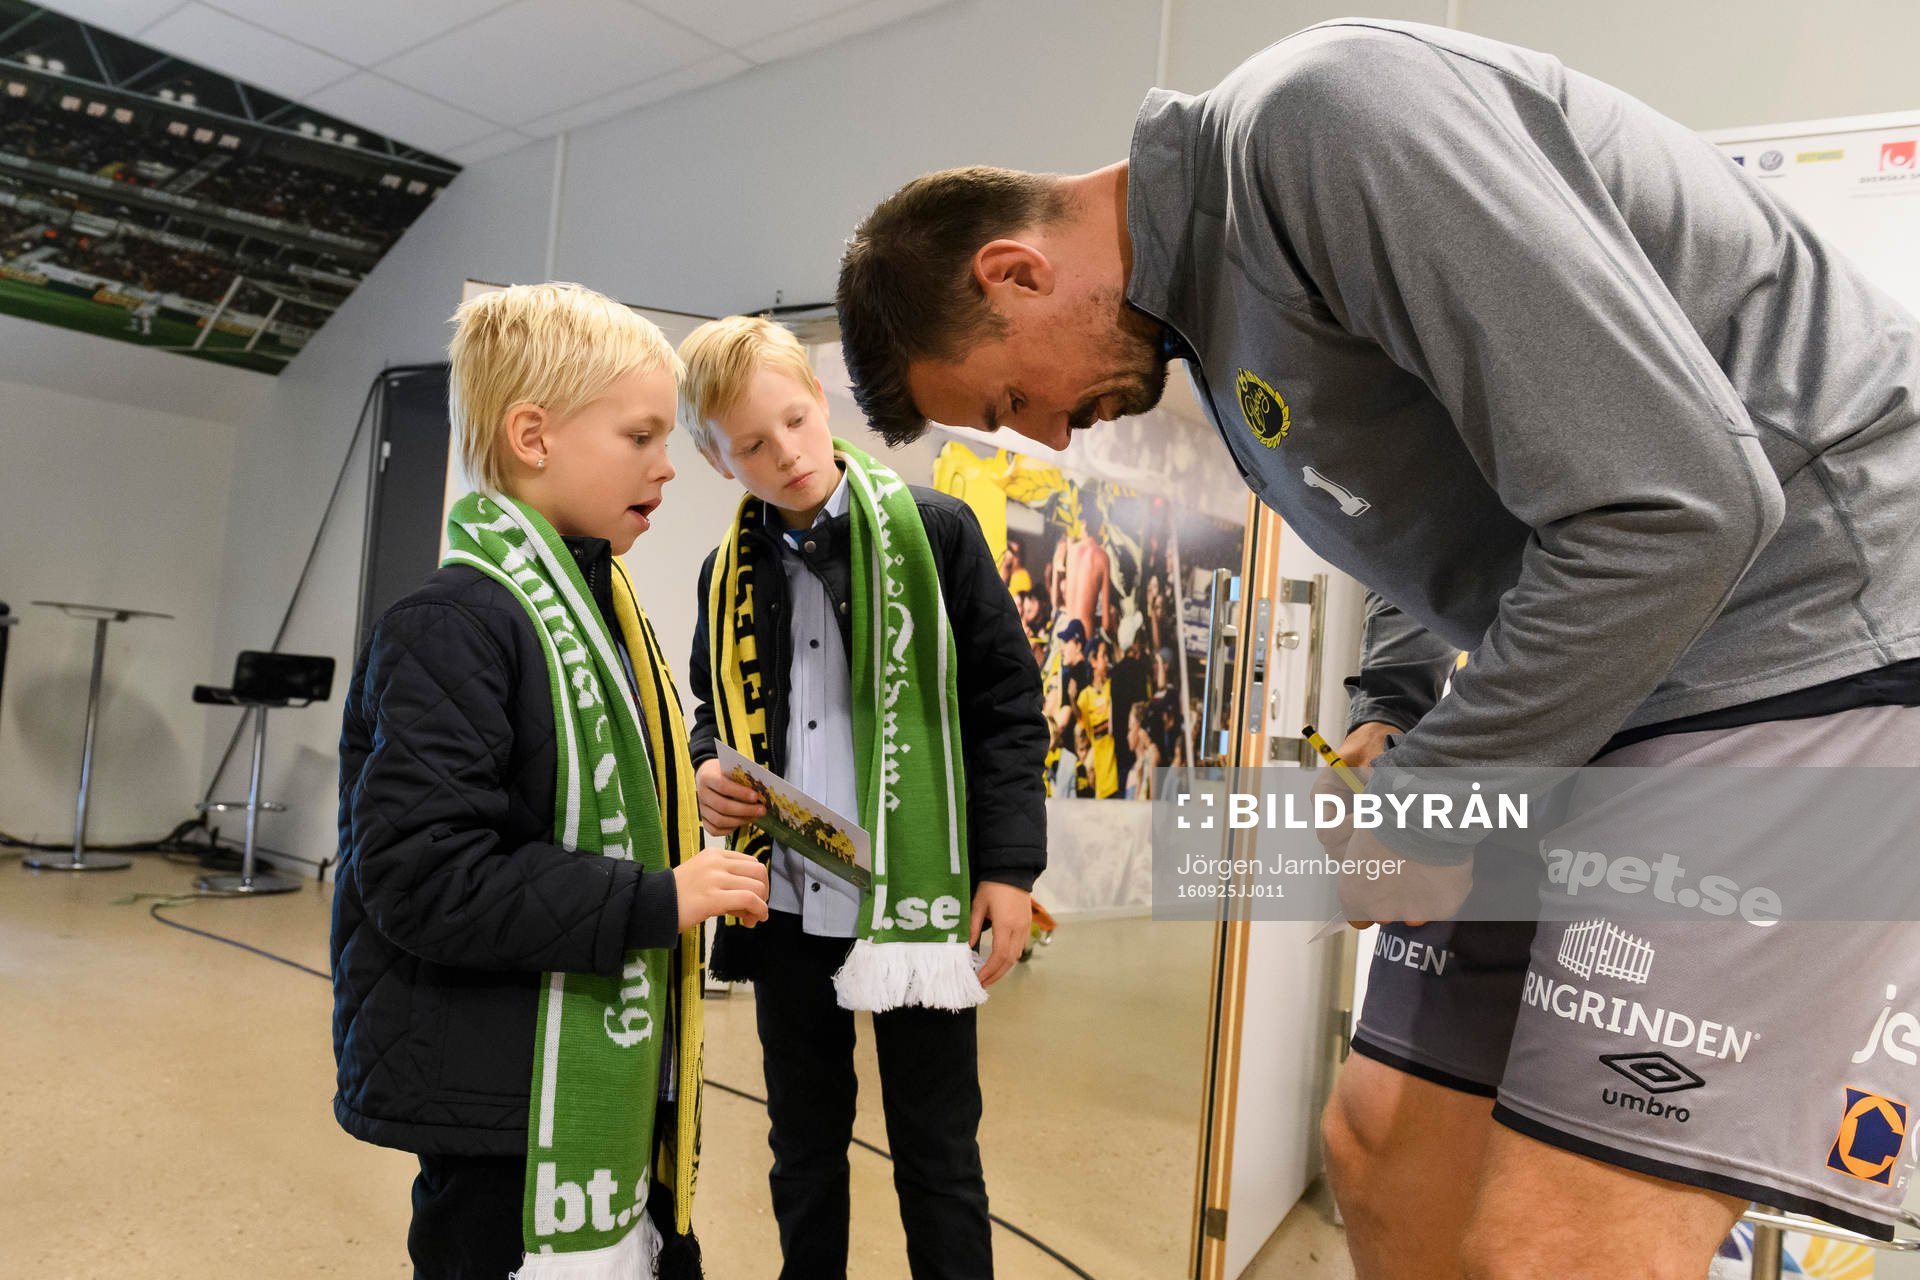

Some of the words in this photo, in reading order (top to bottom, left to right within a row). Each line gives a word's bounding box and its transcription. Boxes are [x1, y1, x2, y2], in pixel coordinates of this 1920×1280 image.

[1539, 840, 1782, 927] apet.se
[1522, 971, 1752, 1063] RNGRINDEN
[1602, 1086, 1690, 1123] umbro
